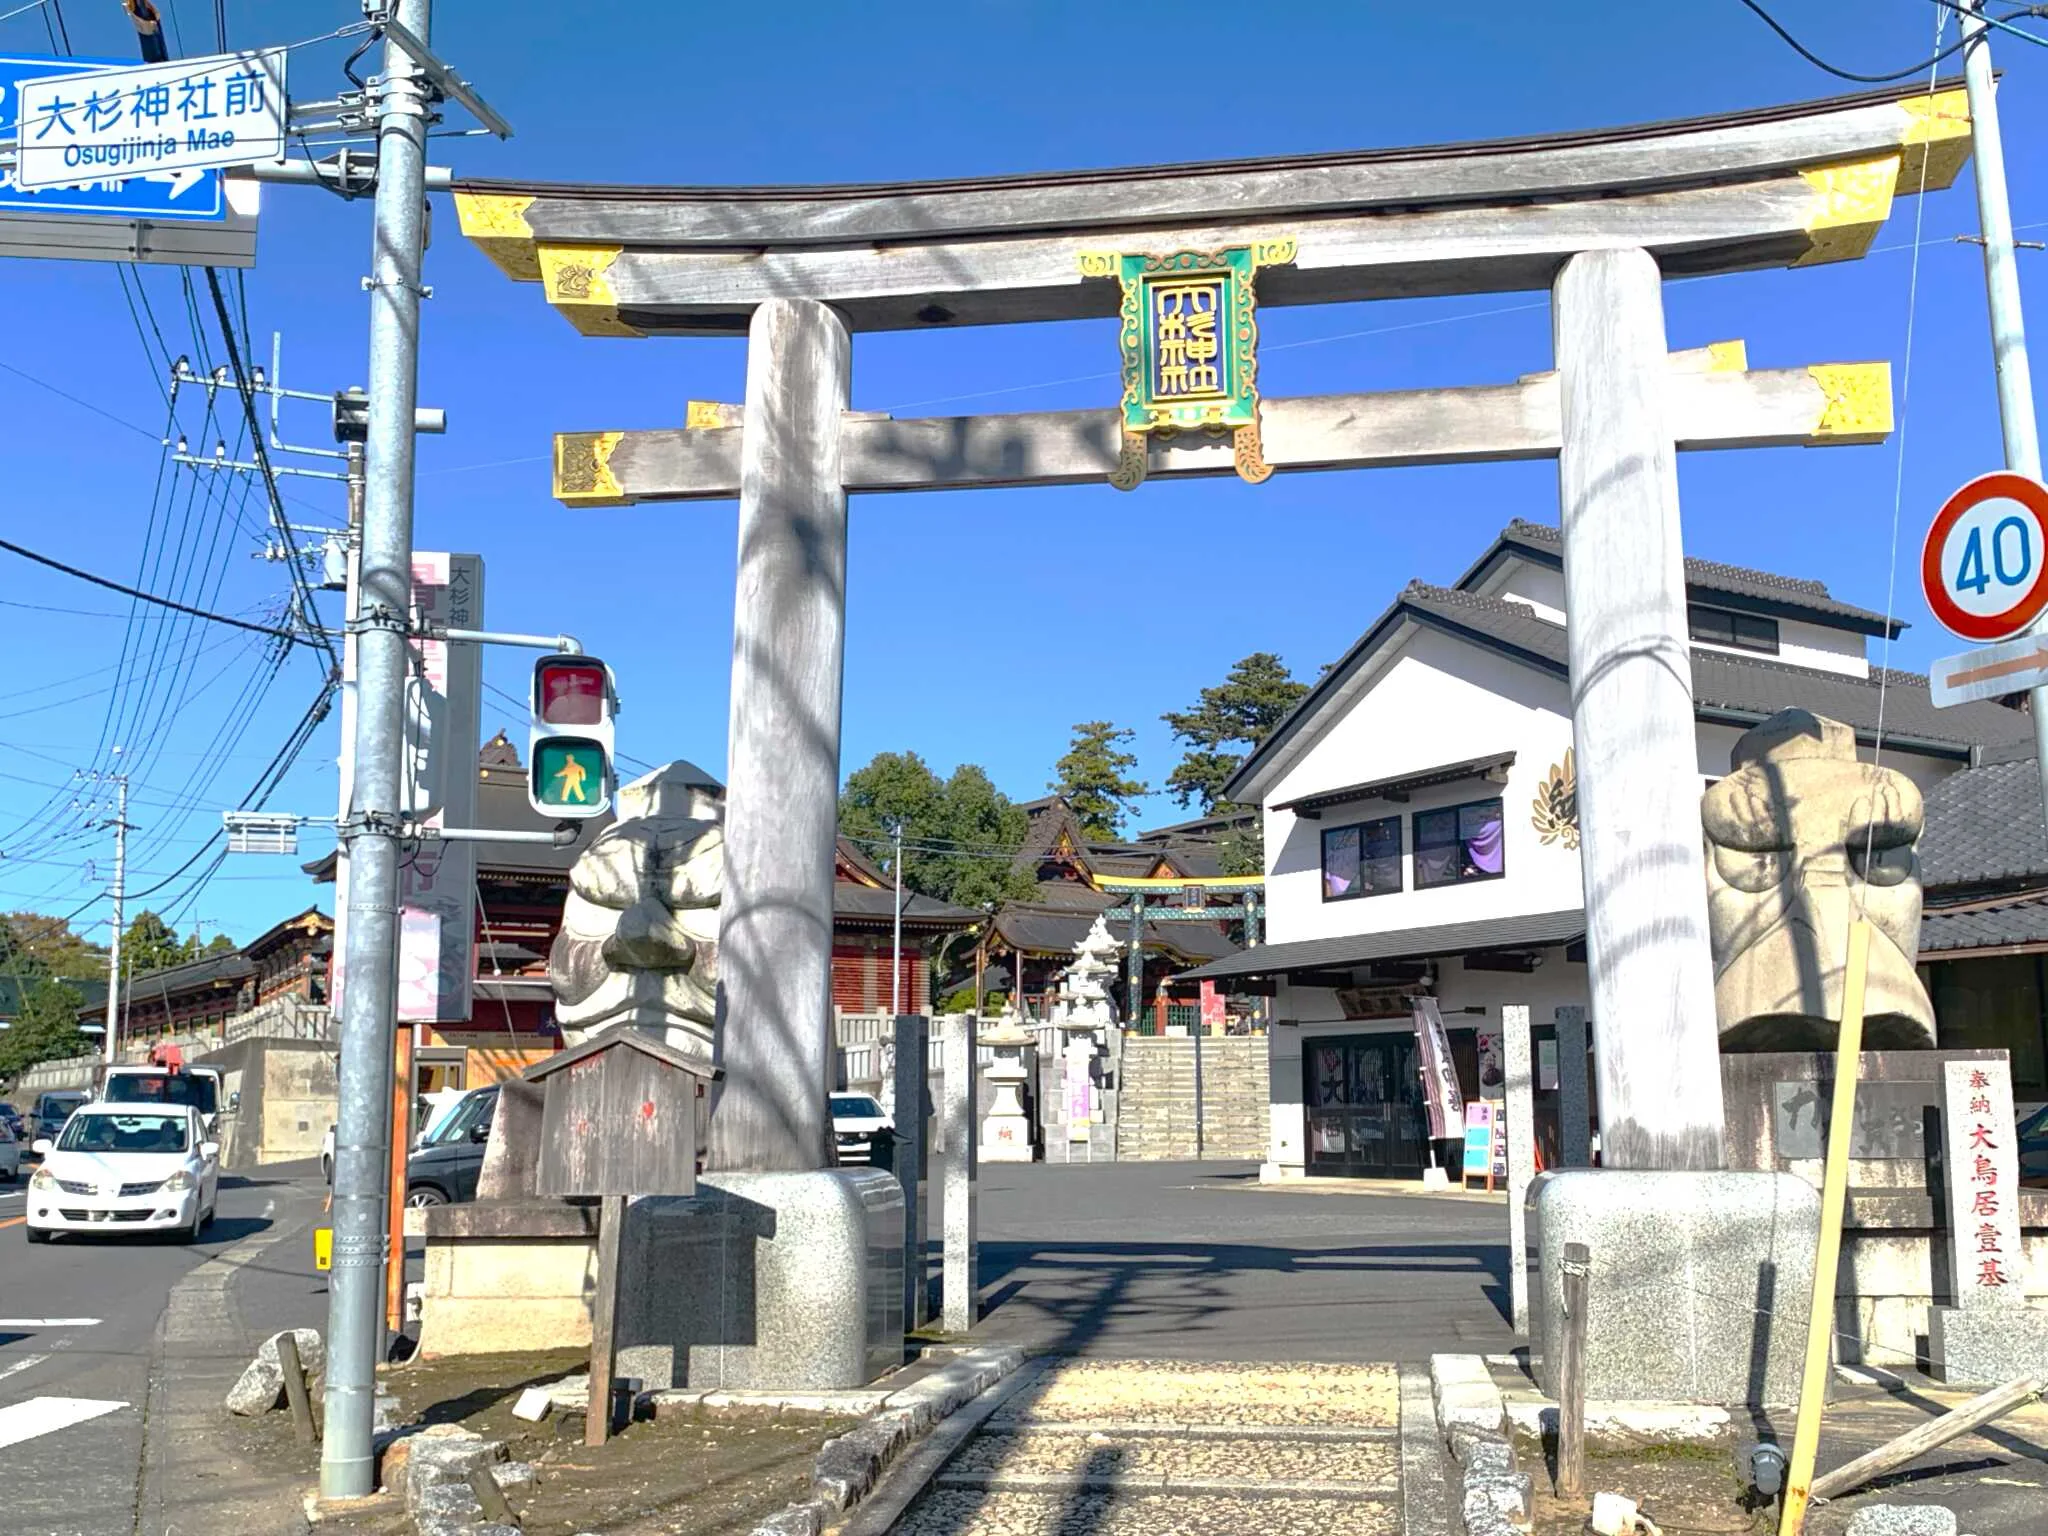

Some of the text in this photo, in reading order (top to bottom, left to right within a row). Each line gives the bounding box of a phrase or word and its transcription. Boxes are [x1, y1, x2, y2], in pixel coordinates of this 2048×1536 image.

[36, 70, 266, 140] 大杉神社前
[64, 127, 235, 167] Osugijinja Mae
[1956, 515, 2031, 595] 40
